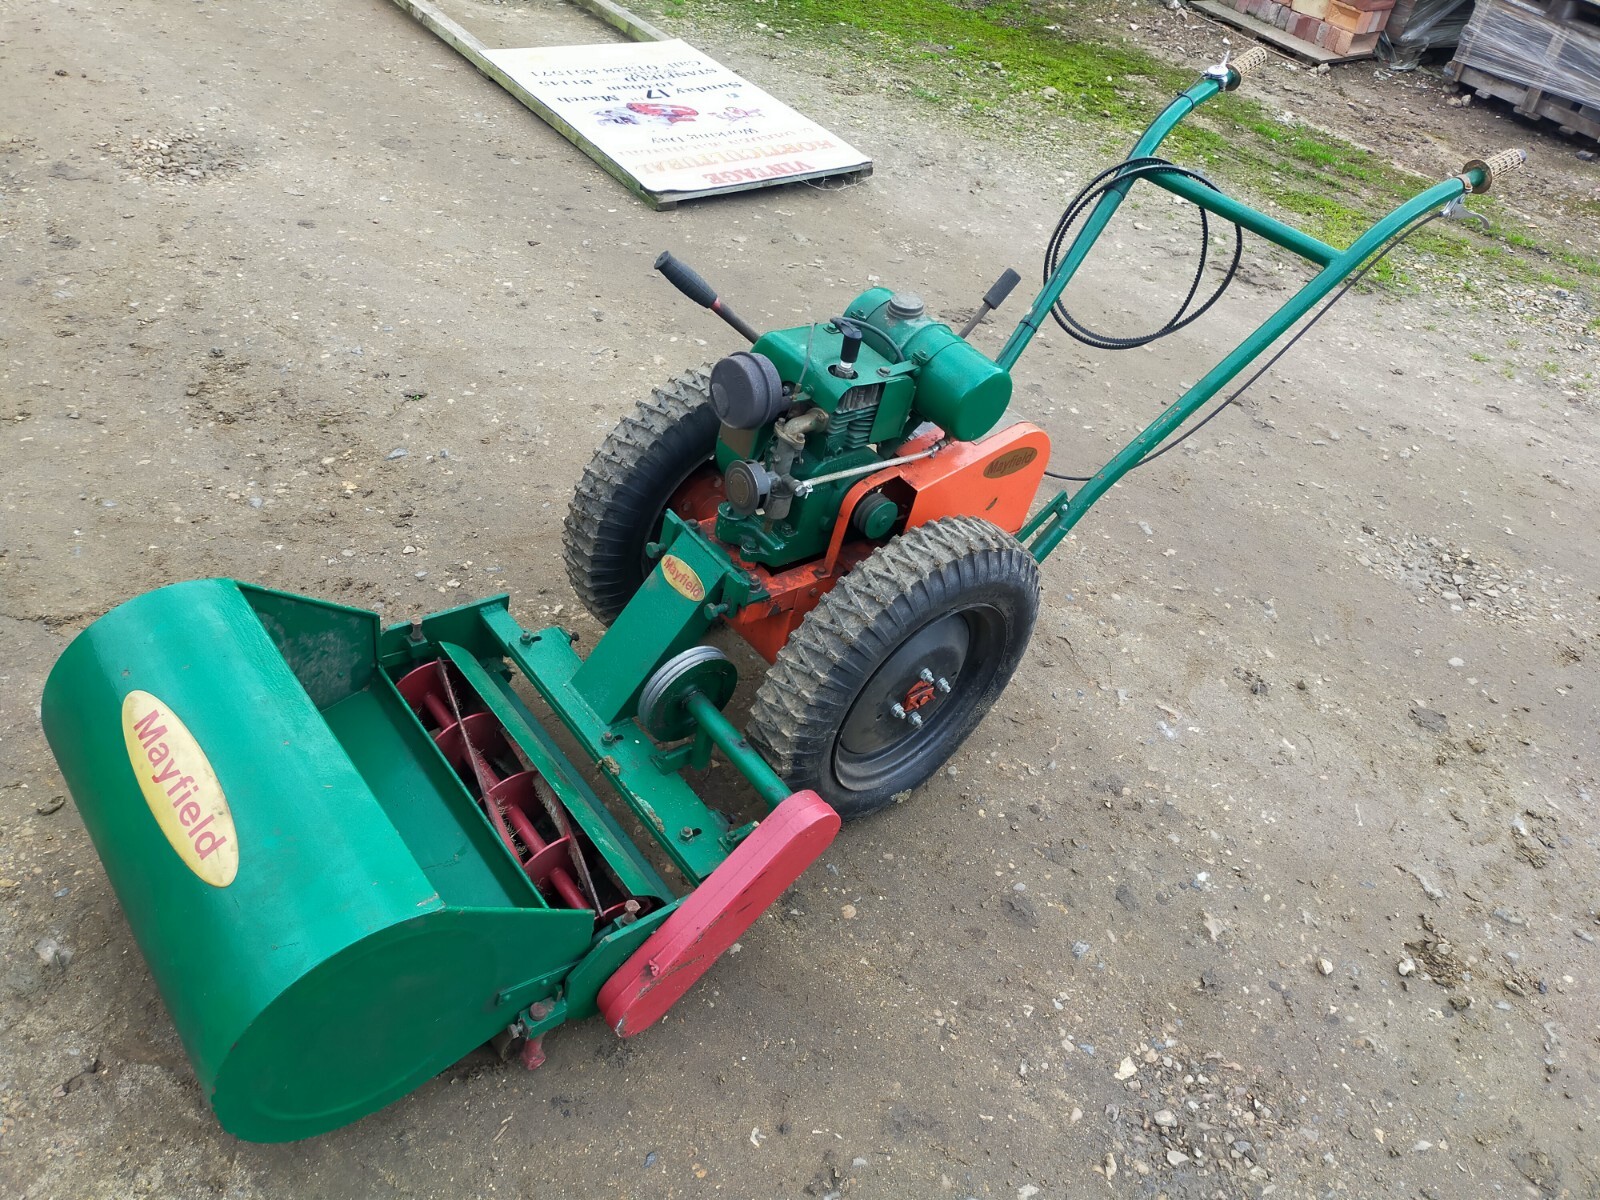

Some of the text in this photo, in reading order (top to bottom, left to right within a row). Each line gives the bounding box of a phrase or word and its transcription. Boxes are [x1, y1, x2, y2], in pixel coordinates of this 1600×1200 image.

[557, 95, 620, 103] March
[676, 82, 742, 94] Sunday
[651, 128, 758, 144] Working Day
[636, 140, 836, 175] HORTICULTURAL
[702, 161, 815, 185] VINTAGE
[987, 451, 1033, 474] Mayfield
[664, 556, 703, 598] Mayfield
[134, 709, 227, 860] Mayfield
